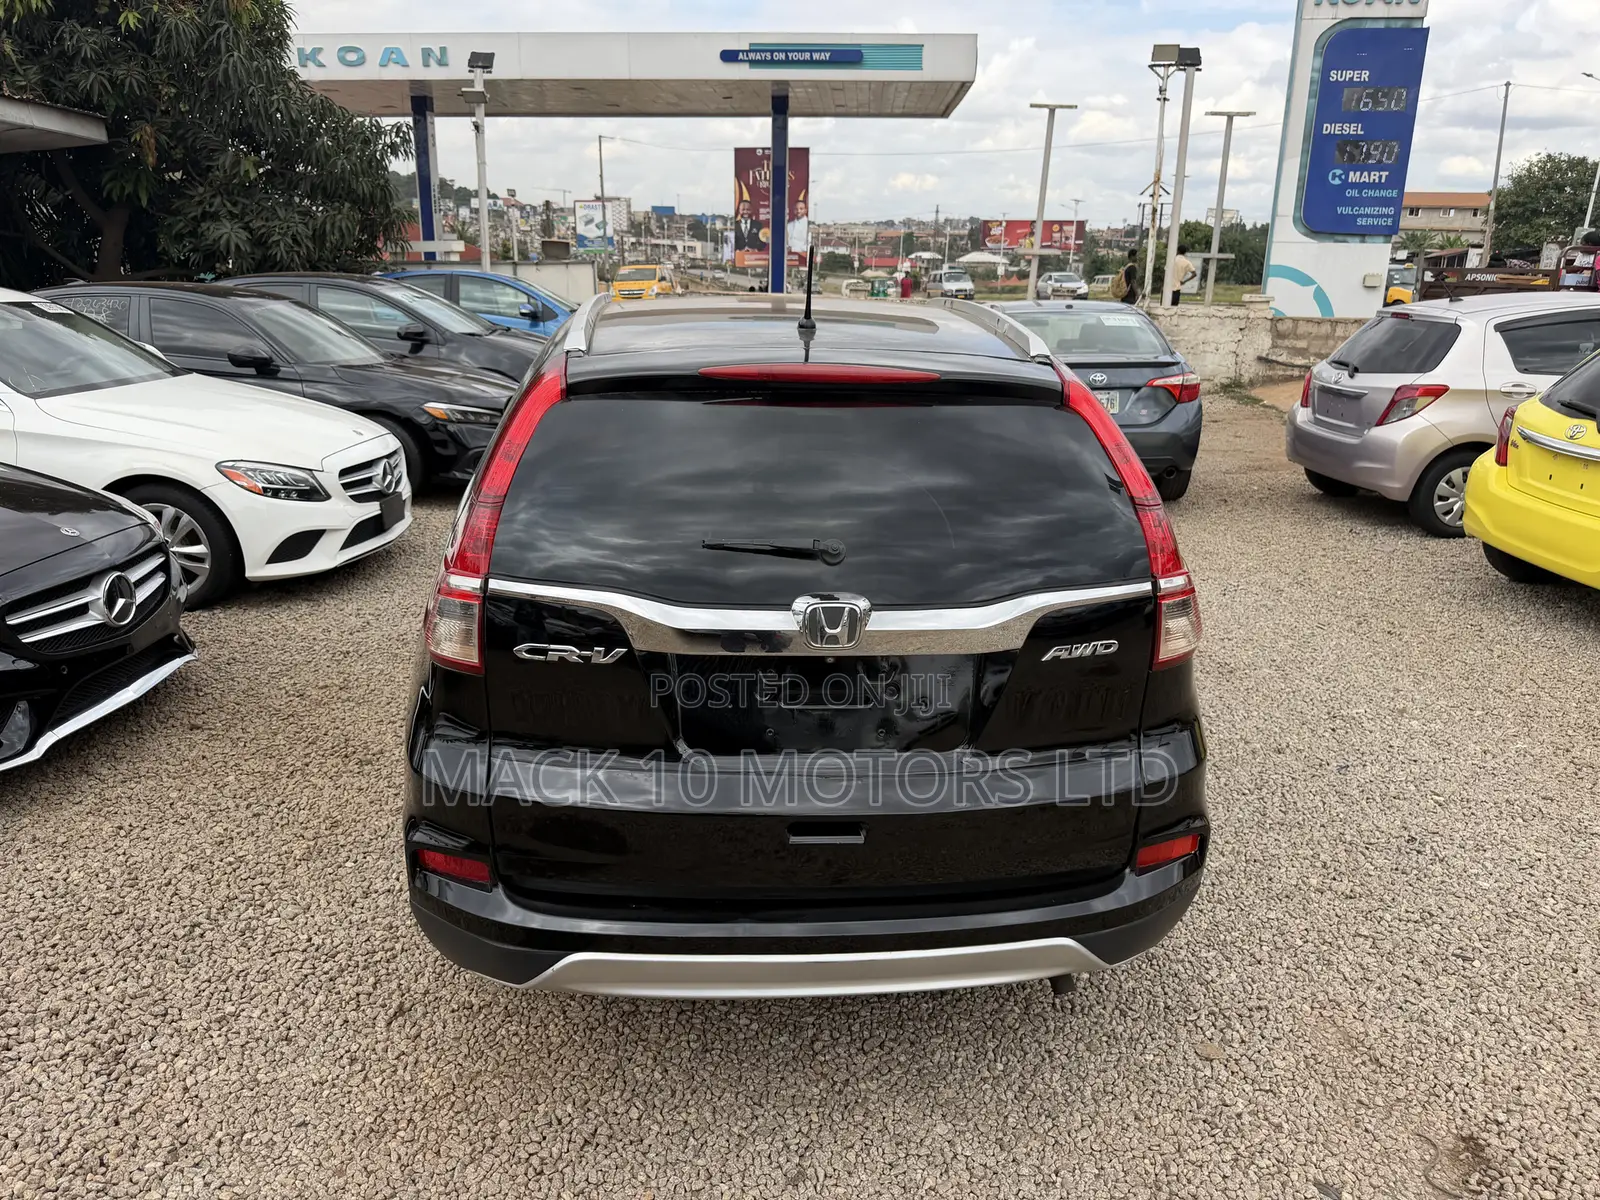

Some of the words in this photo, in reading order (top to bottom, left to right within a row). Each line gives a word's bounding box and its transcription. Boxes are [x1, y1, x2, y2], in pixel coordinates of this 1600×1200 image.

[297, 46, 449, 67] KOAN
[738, 52, 771, 60] ALWAYS
[773, 52, 785, 60] ON
[787, 52, 810, 60] YOUR
[812, 52, 831, 60] WAY
[1329, 70, 1370, 81] SUPER
[1322, 123, 1365, 134] DIESEL
[1348, 171, 1389, 183] MART
[1345, 189, 1360, 197] OIL
[1362, 189, 1399, 197] CHANGE
[1336, 206, 1395, 215] VULCANIZING
[1356, 218, 1393, 226] SERVICE
[513, 643, 628, 664] CR-V
[1041, 639, 1119, 661] AWD
